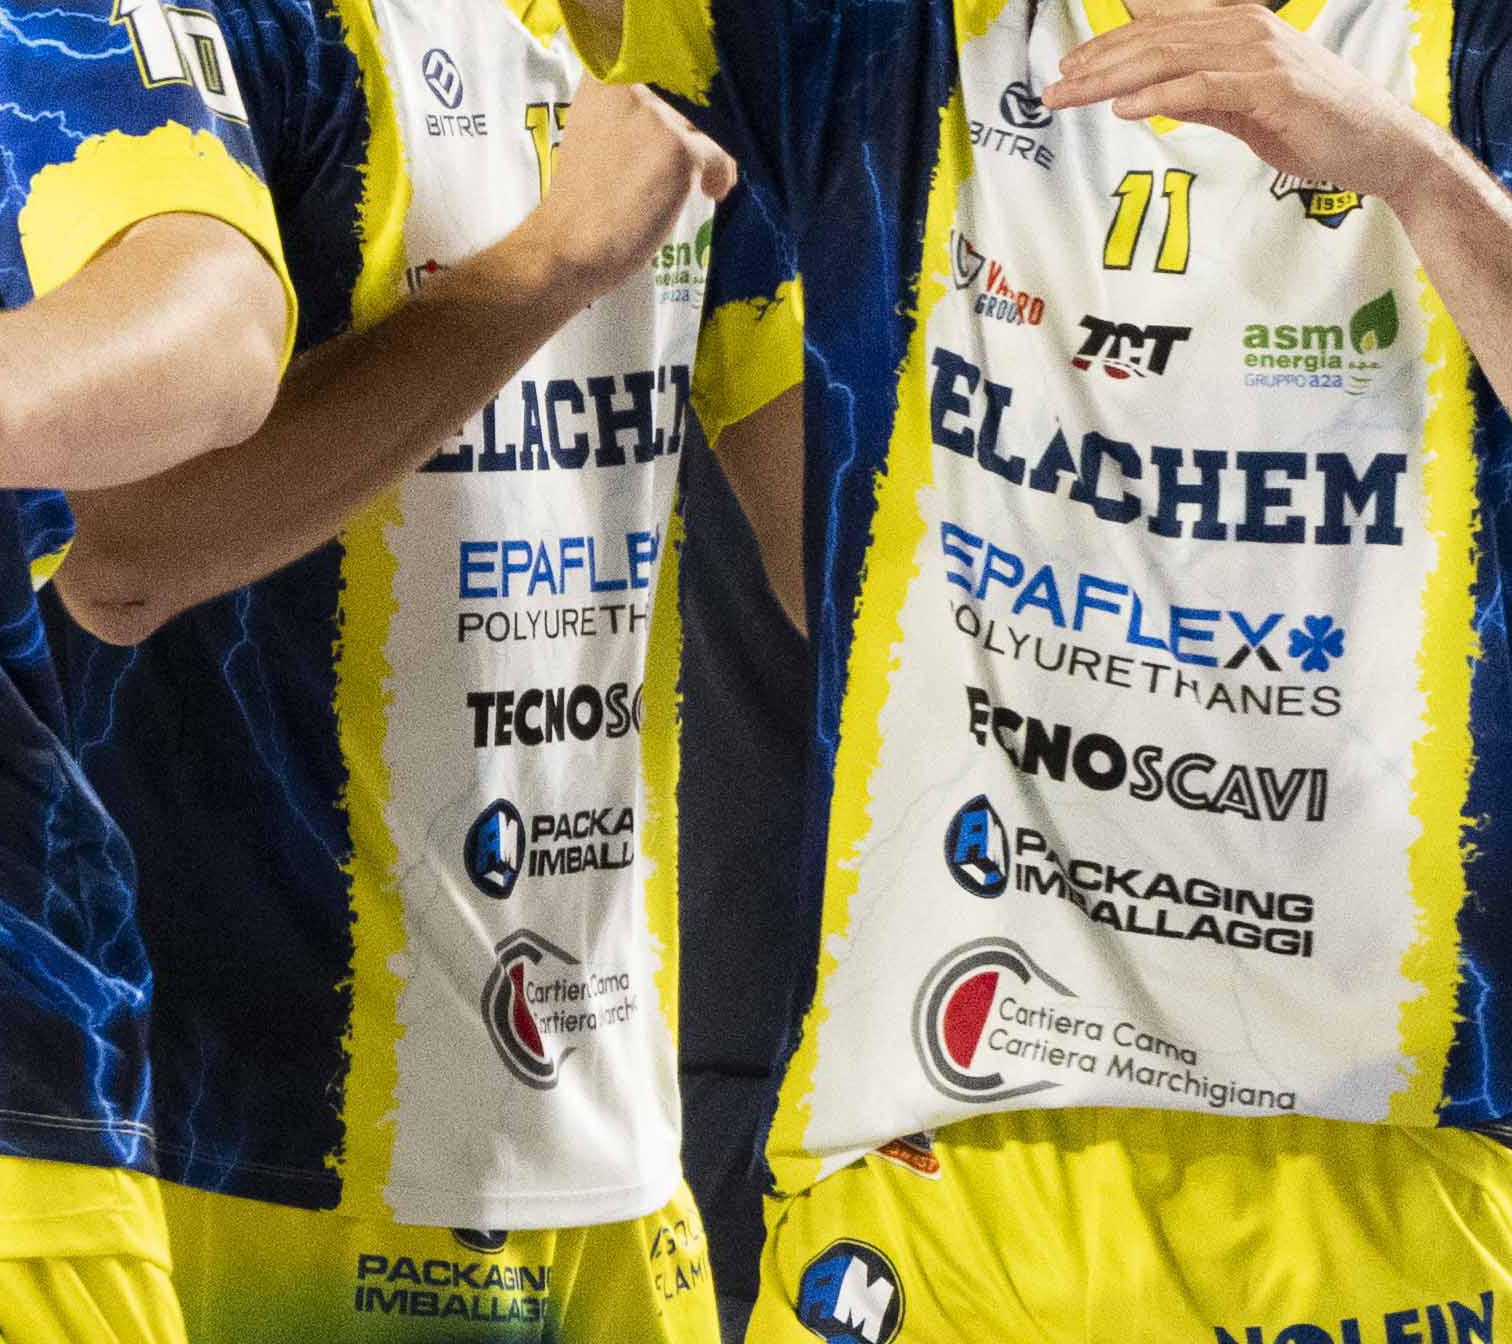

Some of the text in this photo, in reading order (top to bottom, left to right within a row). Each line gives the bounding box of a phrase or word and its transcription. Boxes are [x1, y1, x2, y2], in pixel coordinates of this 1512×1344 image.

[426, 113, 487, 137] BITRE
[1103, 168, 1198, 276] 11
[1243, 322, 1345, 353] asm
[1244, 350, 1343, 373] energia
[930, 347, 1408, 546] ELACHEM
[458, 605, 648, 642] POLYURETH
[940, 521, 1285, 672] EPAFLEX
[950, 600, 1342, 717] OLYURETHANES
[467, 682, 643, 748] TECNOS
[965, 686, 1328, 822] ECNOSCAVI
[531, 807, 635, 843] PACKA
[528, 841, 635, 877] IMBALL
[527, 975, 589, 1006] Cartier
[999, 997, 1197, 1067] Cartiera Cama
[989, 1029, 1296, 1111] Cartiera Marchigiana
